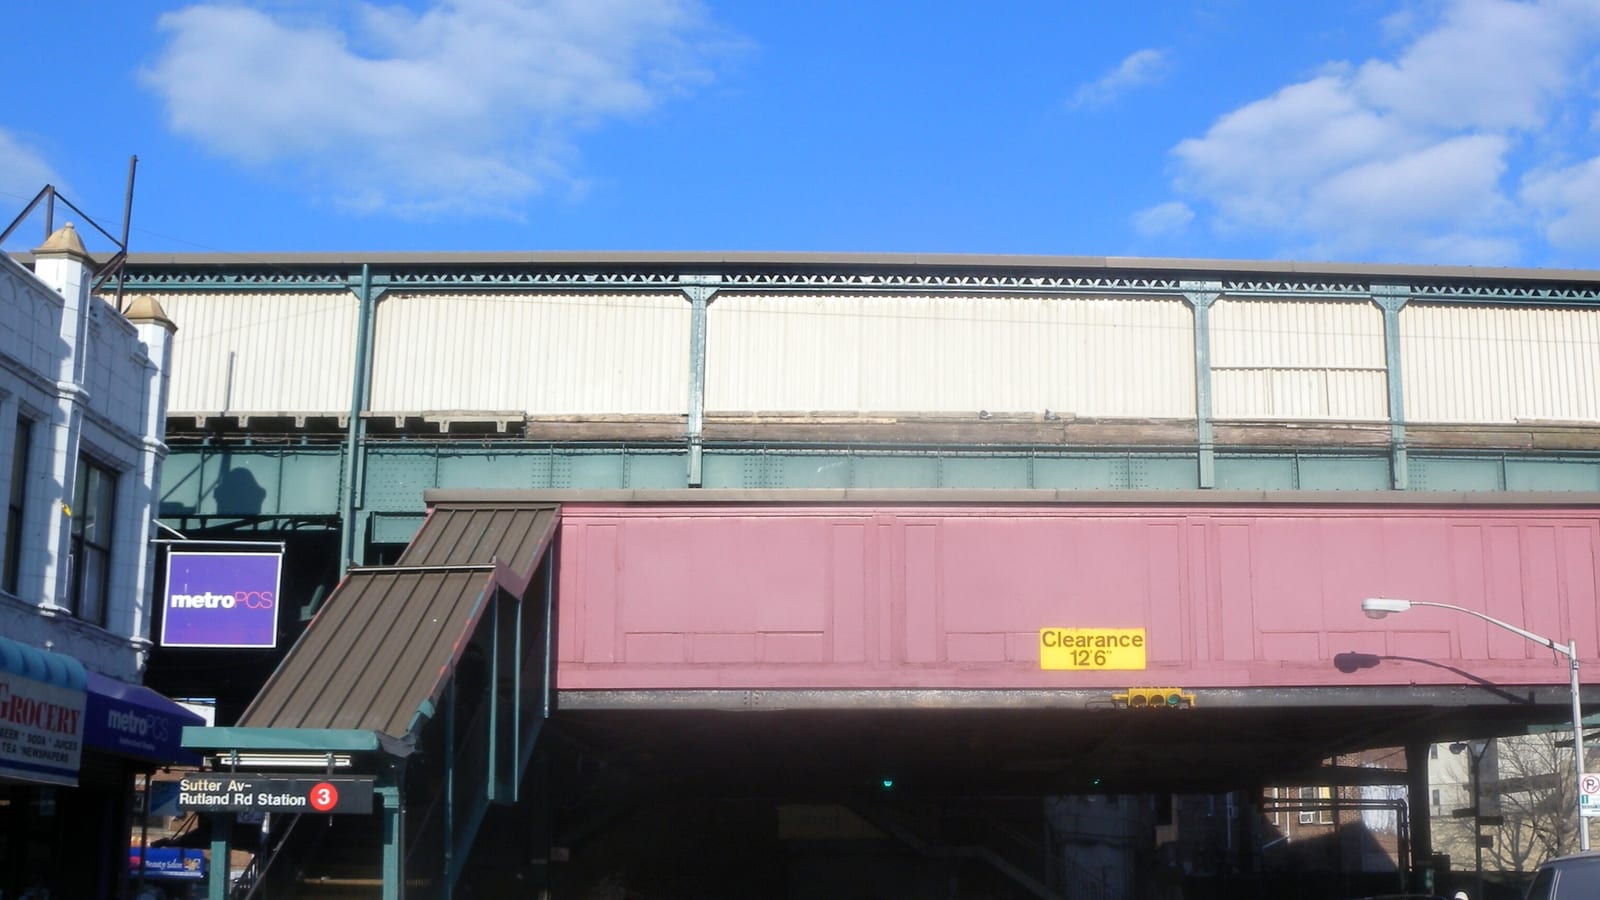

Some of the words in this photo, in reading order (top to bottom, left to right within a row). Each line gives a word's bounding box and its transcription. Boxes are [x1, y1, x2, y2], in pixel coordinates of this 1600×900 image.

[170, 591, 273, 609] metroPCS
[1041, 630, 1143, 648] Clearance
[1070, 649, 1112, 666] 12'6"
[107, 709, 169, 742] metroPCS
[2, 742, 17, 753] TEA
[27, 733, 46, 745] SODA
[53, 738, 78, 751] JUICES
[180, 779, 222, 792] Sutter
[227, 780, 252, 792] Av-
[179, 793, 229, 805] Rutland
[234, 793, 253, 805] Rd
[257, 793, 306, 806] Station
[317, 788, 331, 805] 3
